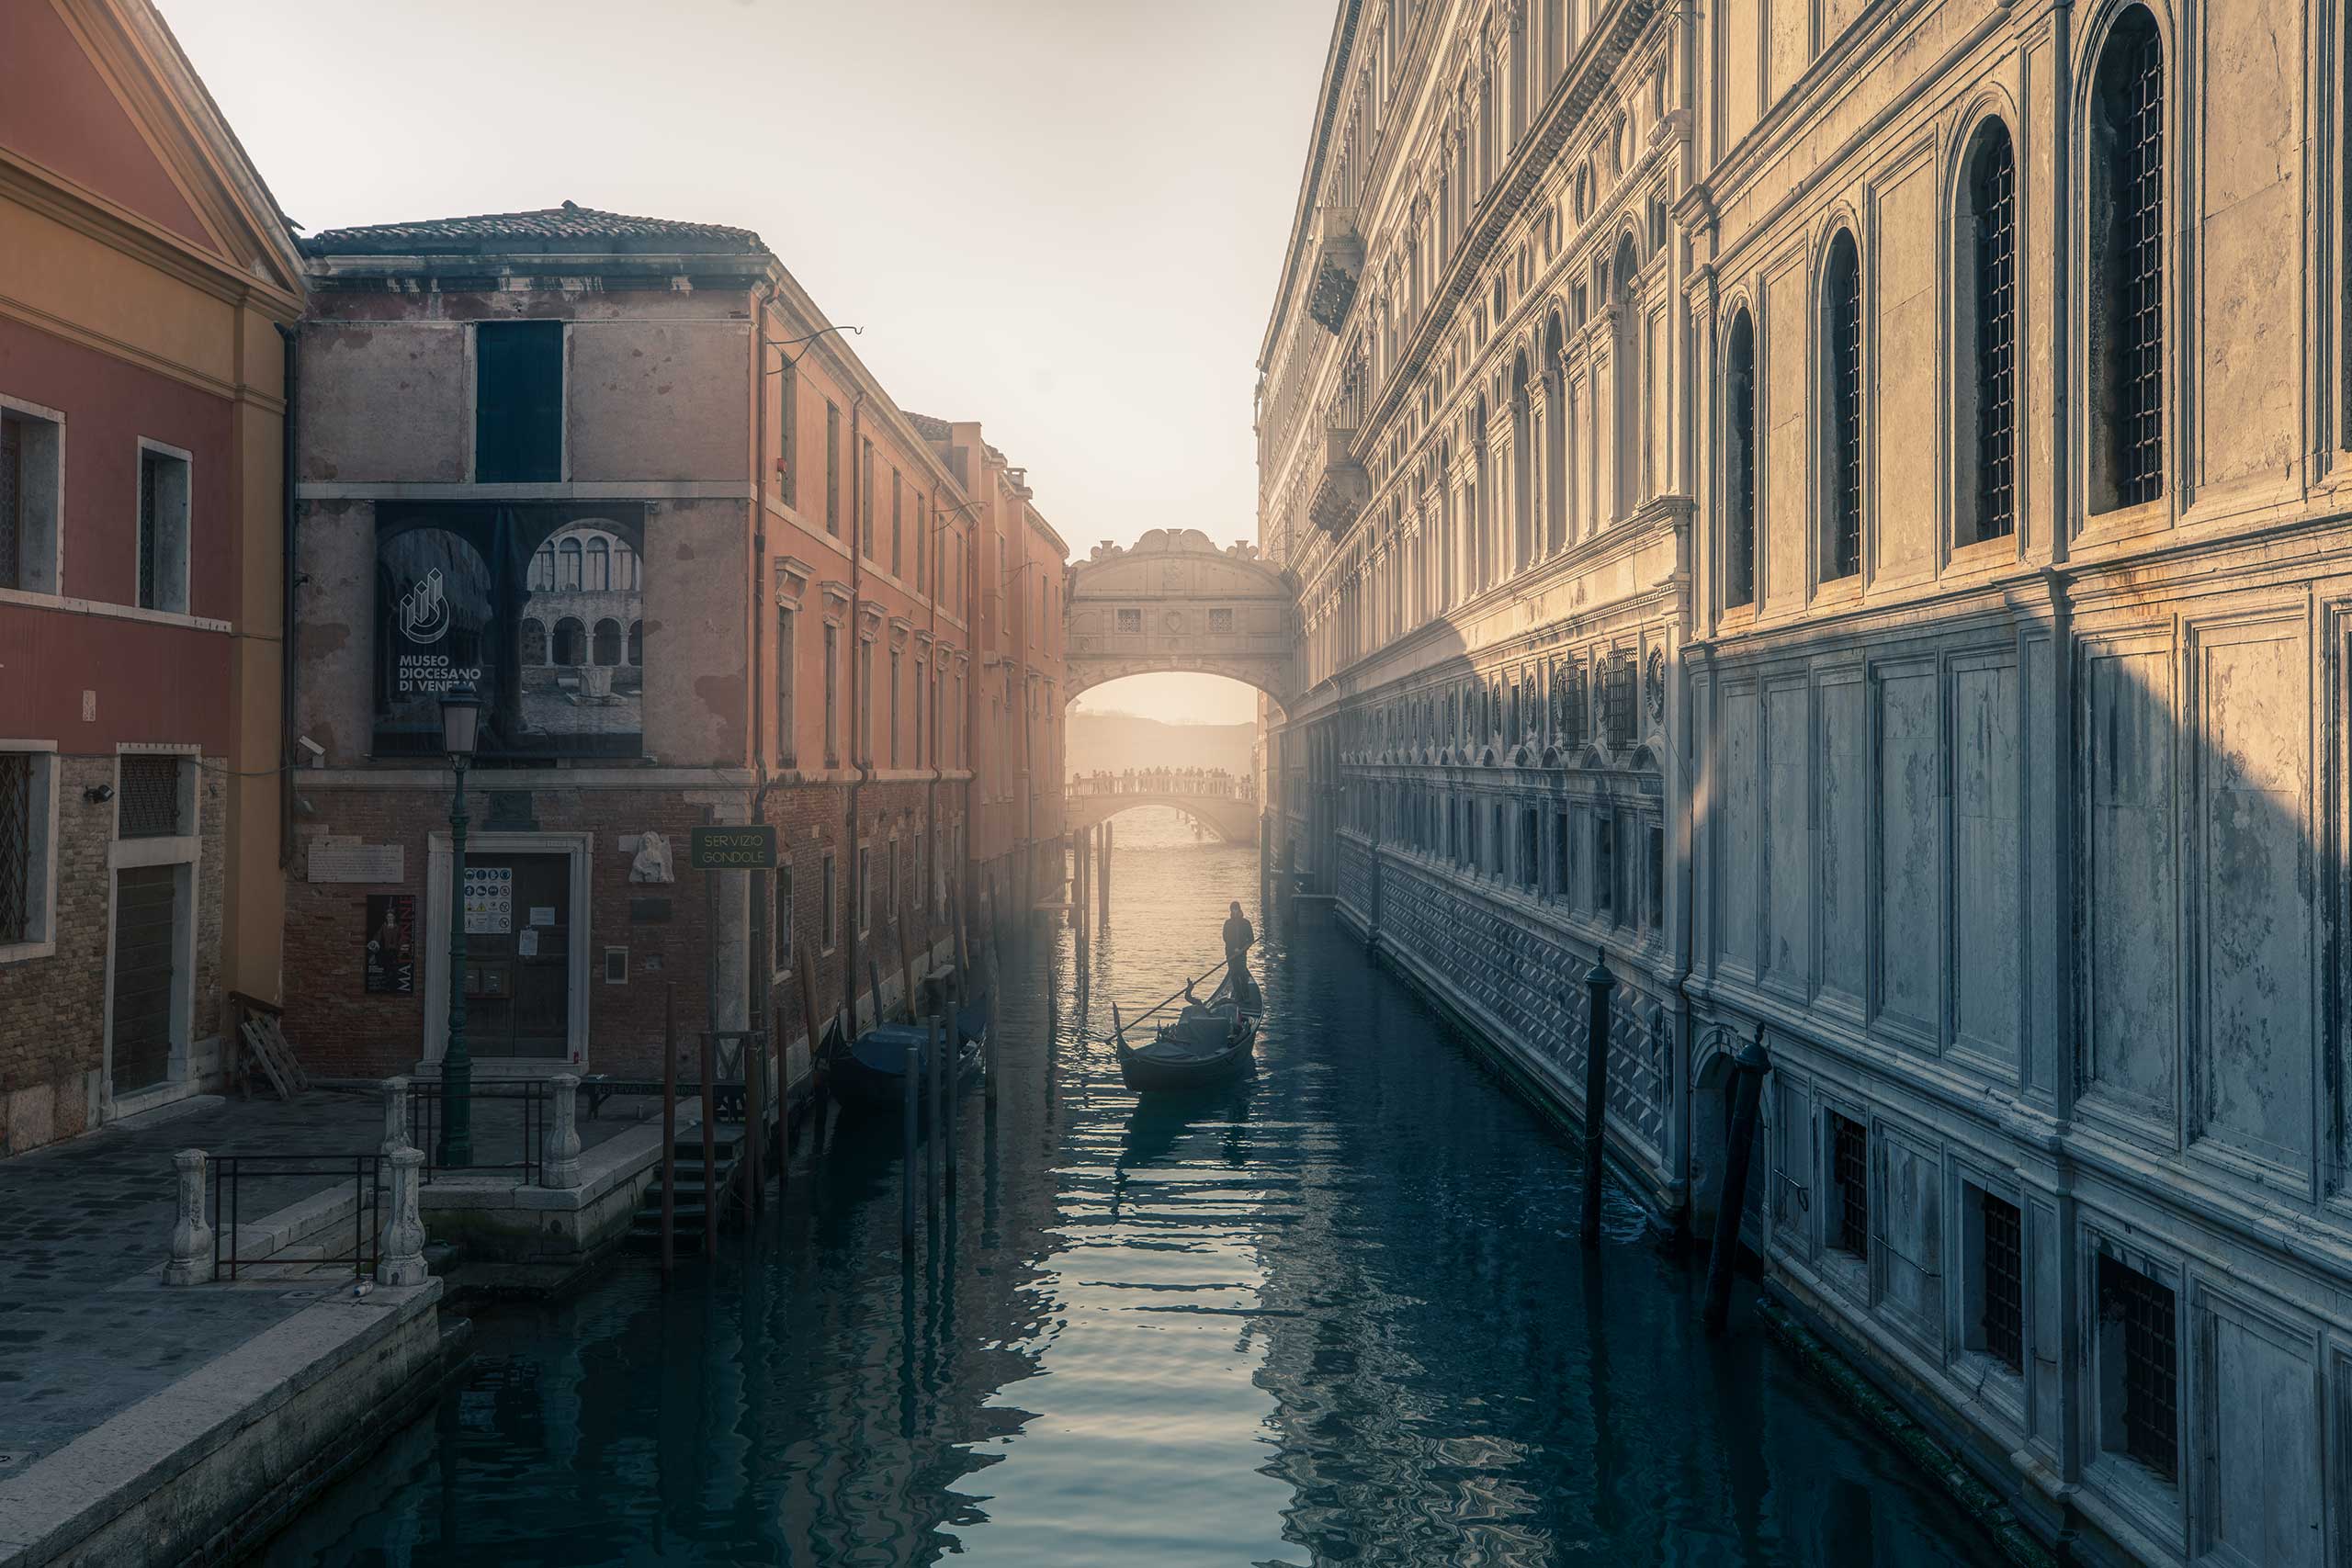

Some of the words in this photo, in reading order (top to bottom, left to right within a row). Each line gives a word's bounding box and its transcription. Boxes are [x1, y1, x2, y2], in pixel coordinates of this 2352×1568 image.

[400, 655, 449, 667] MUSEO
[400, 668, 481, 680] DIOCESANO
[400, 680, 413, 692] DI
[417, 680, 477, 692] VENEA
[704, 835, 764, 847] SERVIZIO
[702, 851, 765, 863] GONDOLE
[397, 896, 413, 993] MADONNE
